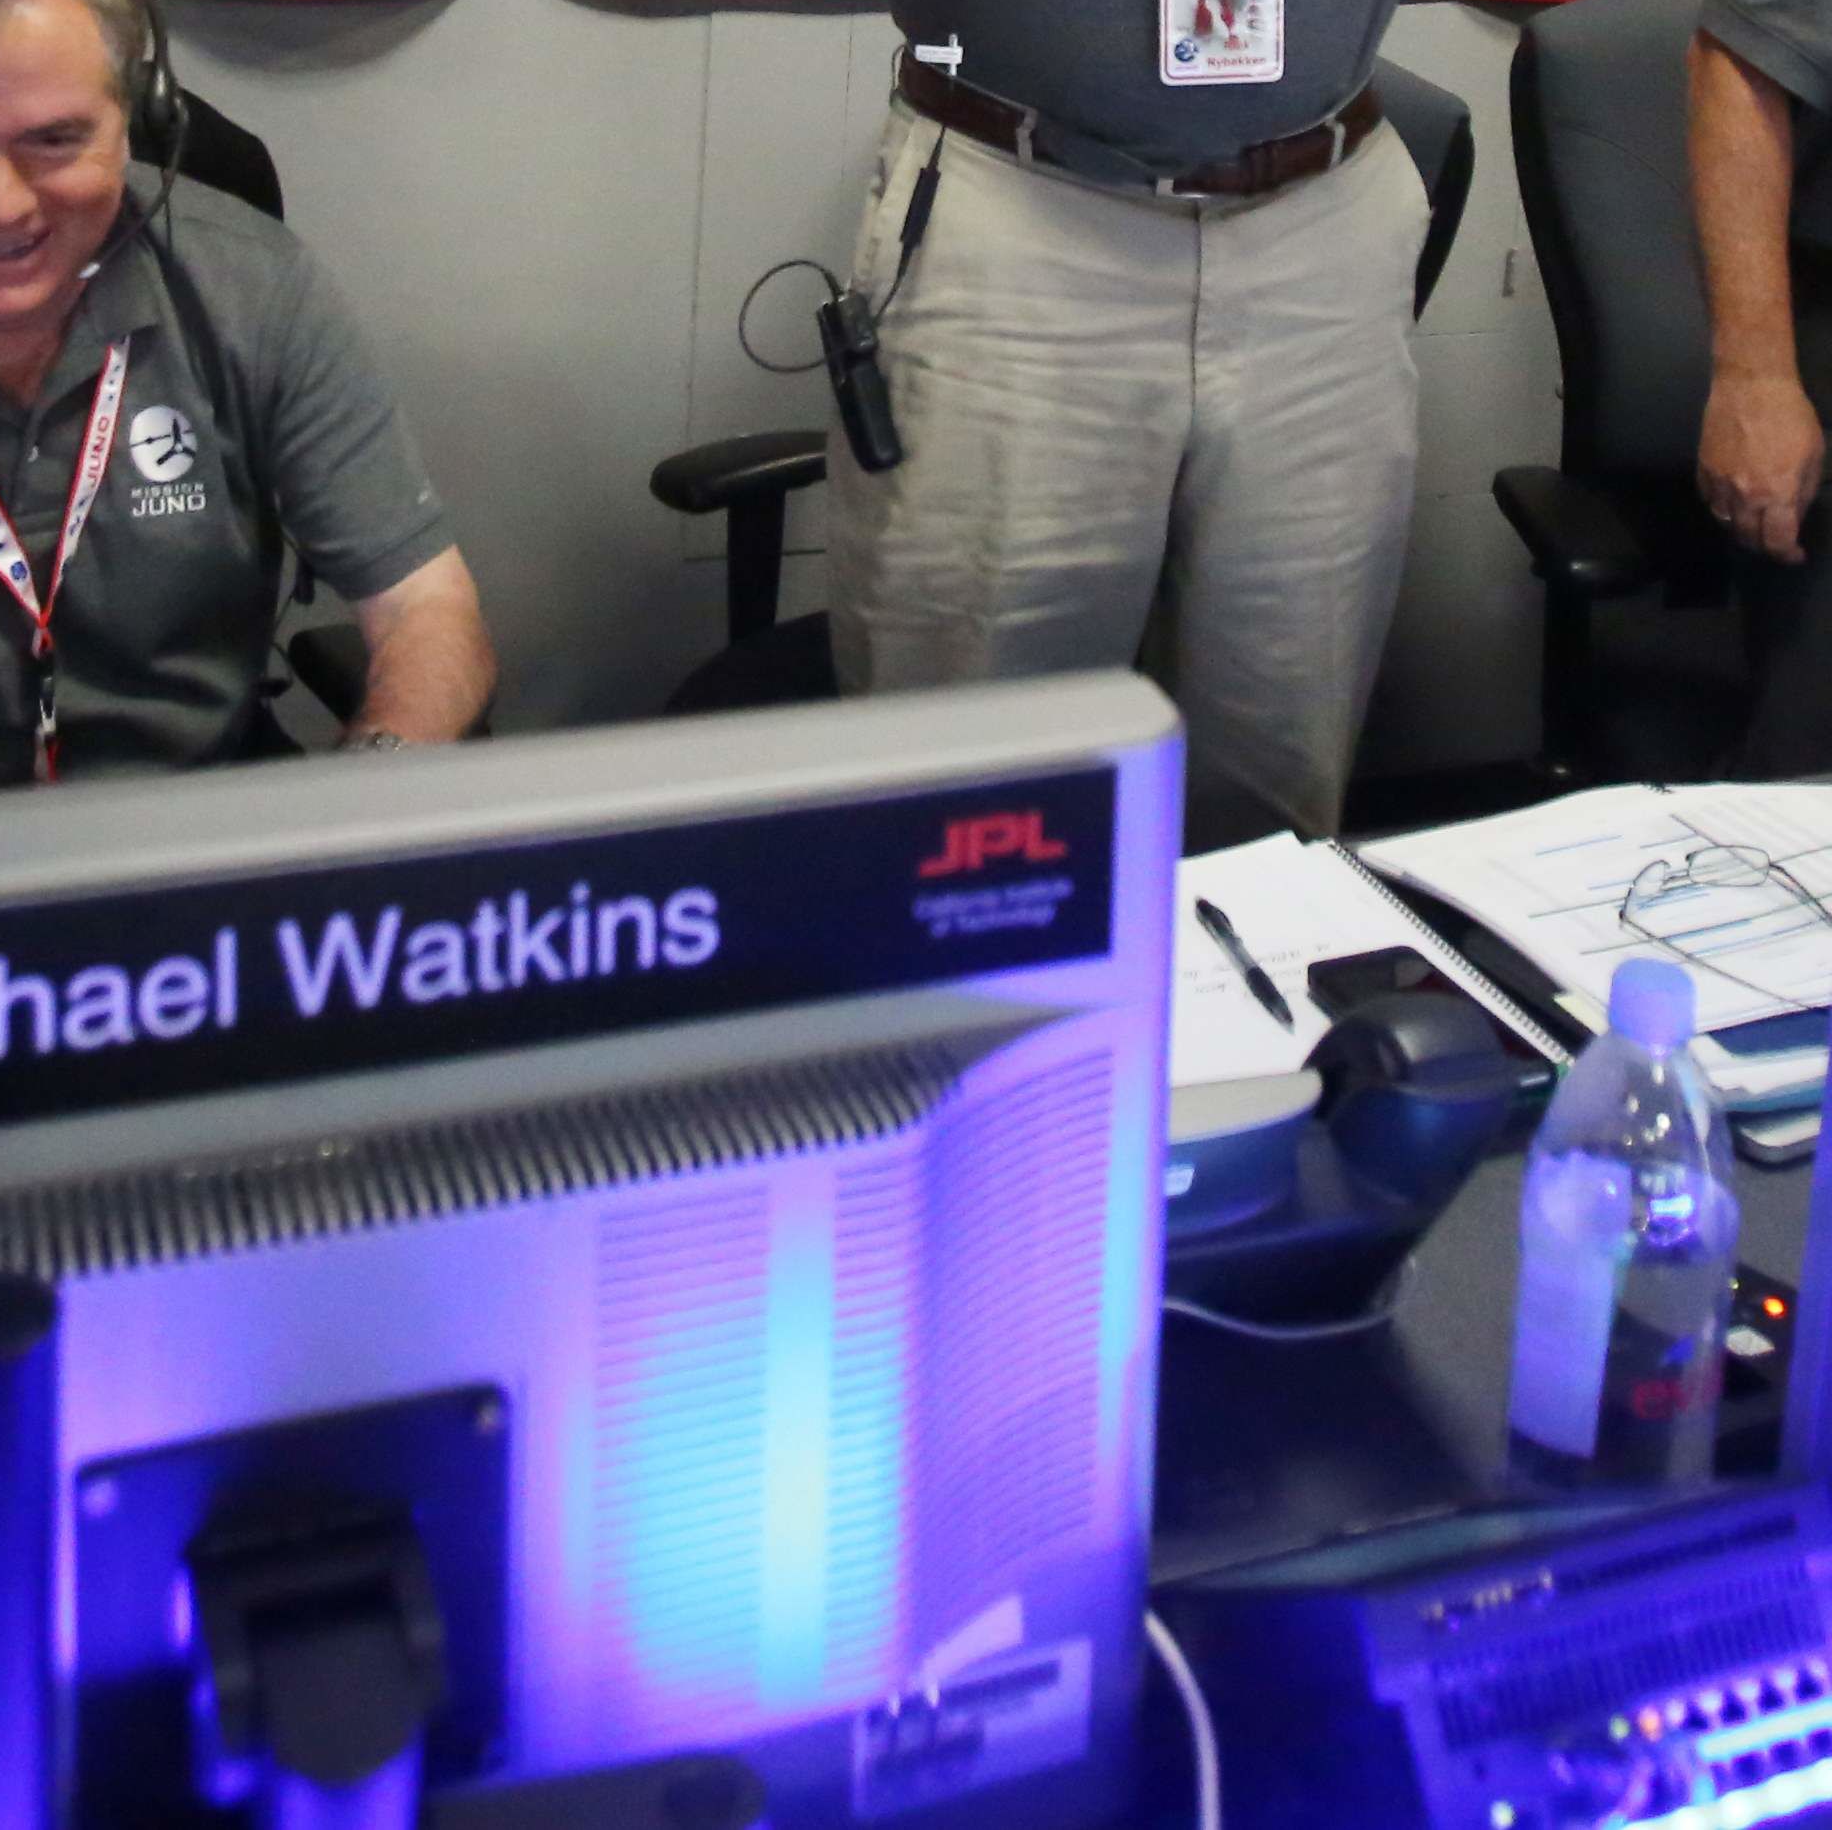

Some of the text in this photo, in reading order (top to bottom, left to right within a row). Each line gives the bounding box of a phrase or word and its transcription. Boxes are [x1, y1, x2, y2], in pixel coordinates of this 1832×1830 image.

[88, 415, 110, 489] JUNO
[132, 493, 207, 517] JUNO
[919, 809, 1067, 878] JPL
[276, 881, 722, 1020] Watkins
